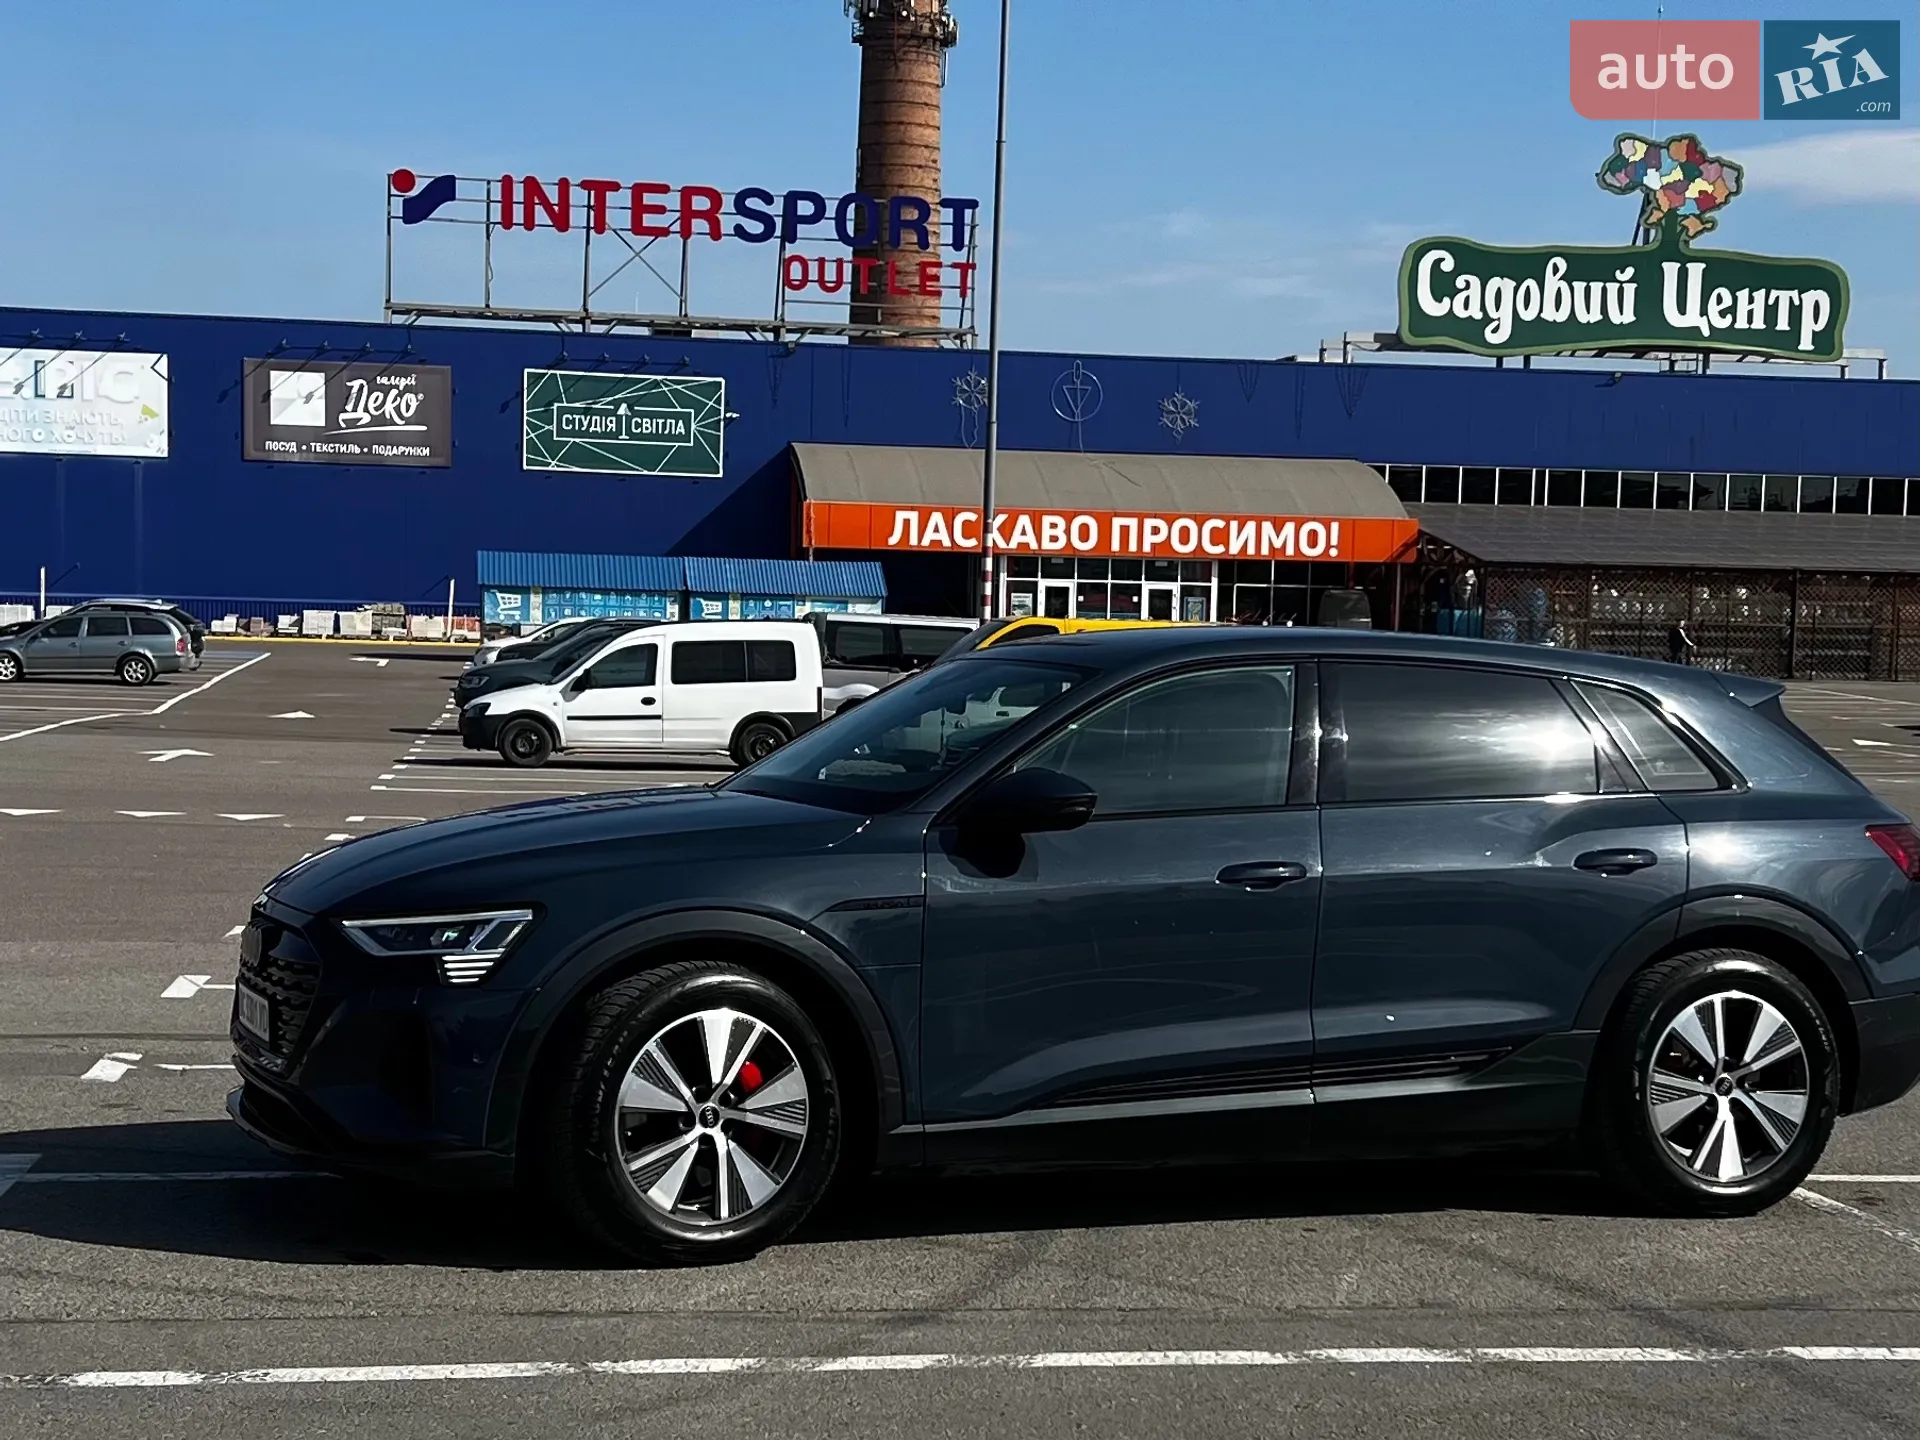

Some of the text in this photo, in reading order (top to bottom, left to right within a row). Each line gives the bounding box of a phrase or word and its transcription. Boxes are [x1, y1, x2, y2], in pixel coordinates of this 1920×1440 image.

[499, 173, 980, 252] INTERSPORT
[784, 254, 976, 298] OUTLET
[1417, 249, 1832, 352] Садовий Центр
[338, 378, 419, 428] Деко
[561, 413, 686, 436] СТУДІЯ СВІТЛА
[265, 440, 430, 457] ПОСУД ТЕКСТИЛЬ ПОДАРУНКИ
[887, 509, 1340, 558] ЛАСКАВО ПРОСИМО!
